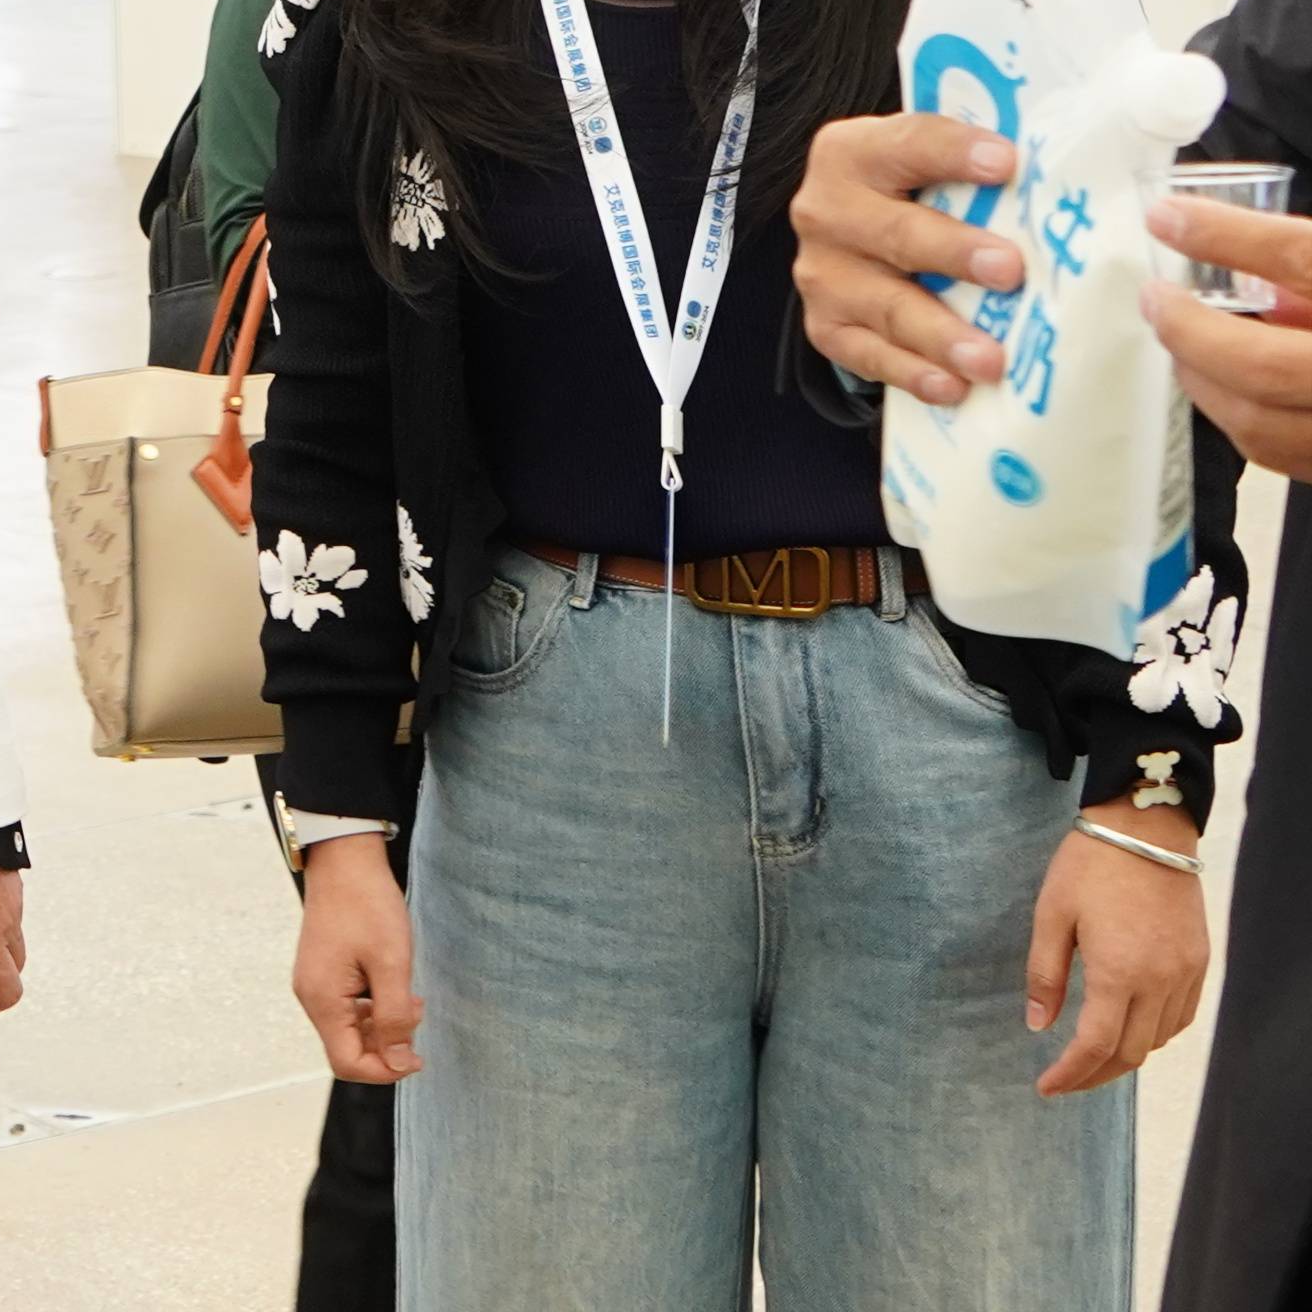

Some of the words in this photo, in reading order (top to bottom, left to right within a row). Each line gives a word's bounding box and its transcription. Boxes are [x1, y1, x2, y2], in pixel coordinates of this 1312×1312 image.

[604, 183, 659, 339] 艾克思博国际会展集团
